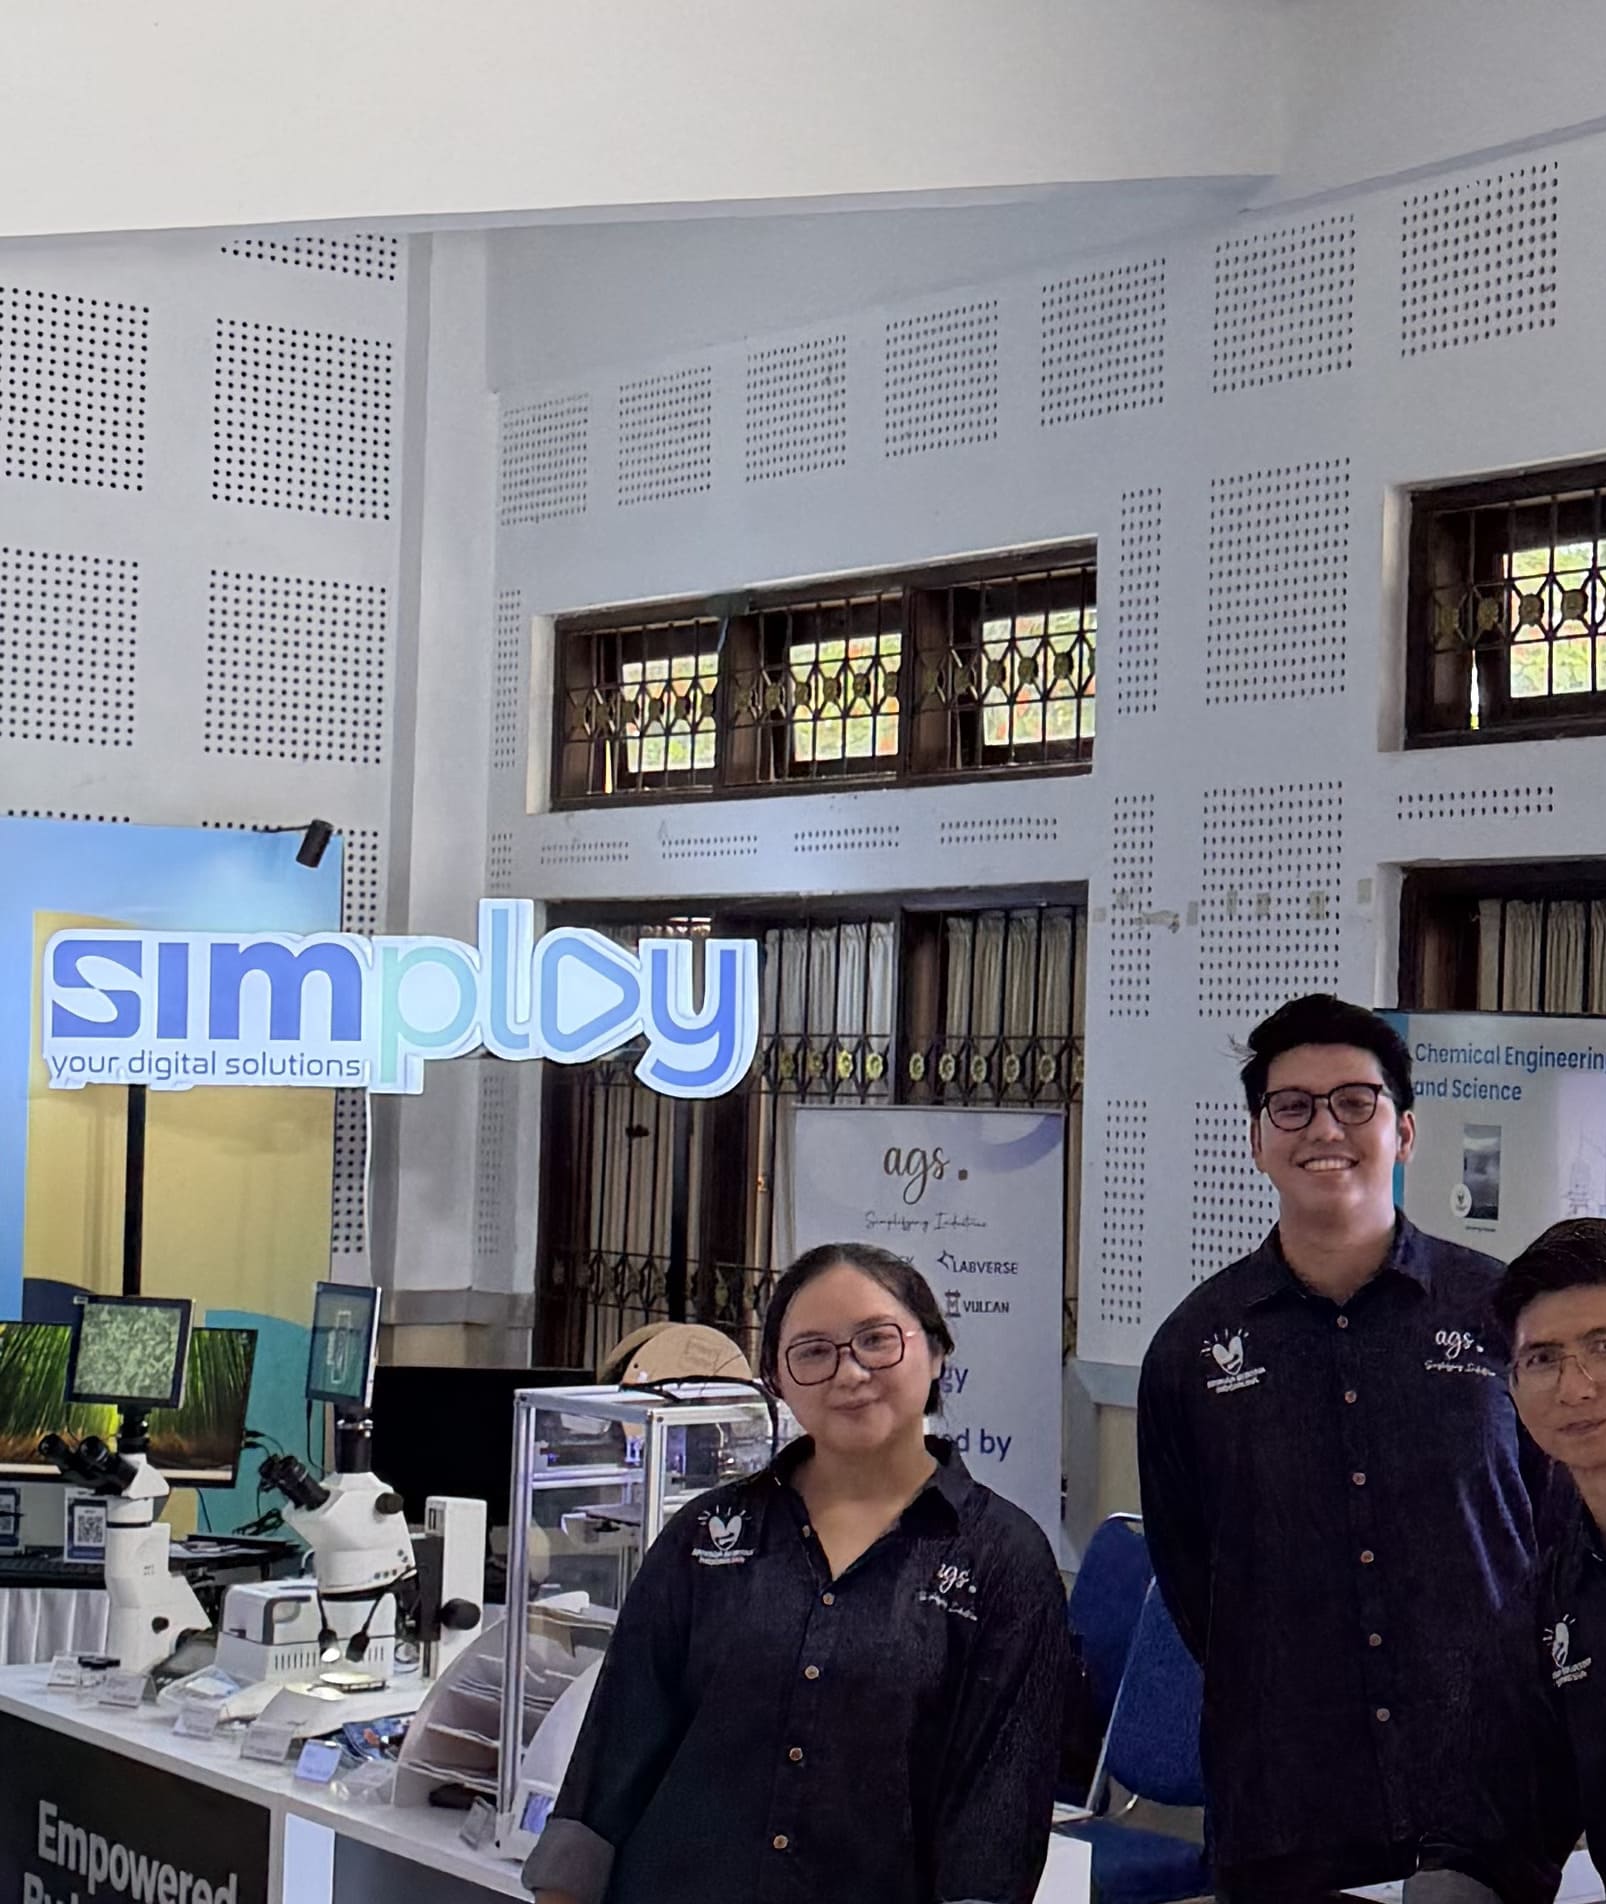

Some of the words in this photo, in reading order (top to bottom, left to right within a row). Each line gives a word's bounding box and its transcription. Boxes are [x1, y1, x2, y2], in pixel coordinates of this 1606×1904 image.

[51, 1053, 121, 1079] your
[127, 1049, 216, 1080] digital
[225, 1050, 361, 1077] solutions
[1415, 1042, 1501, 1065] Chemical
[1413, 1077, 1448, 1098] and
[1452, 1077, 1522, 1101] Science
[952, 1260, 1018, 1275] LABVERSE
[963, 1300, 1011, 1314] VULCAN
[980, 1427, 1012, 1463] by
